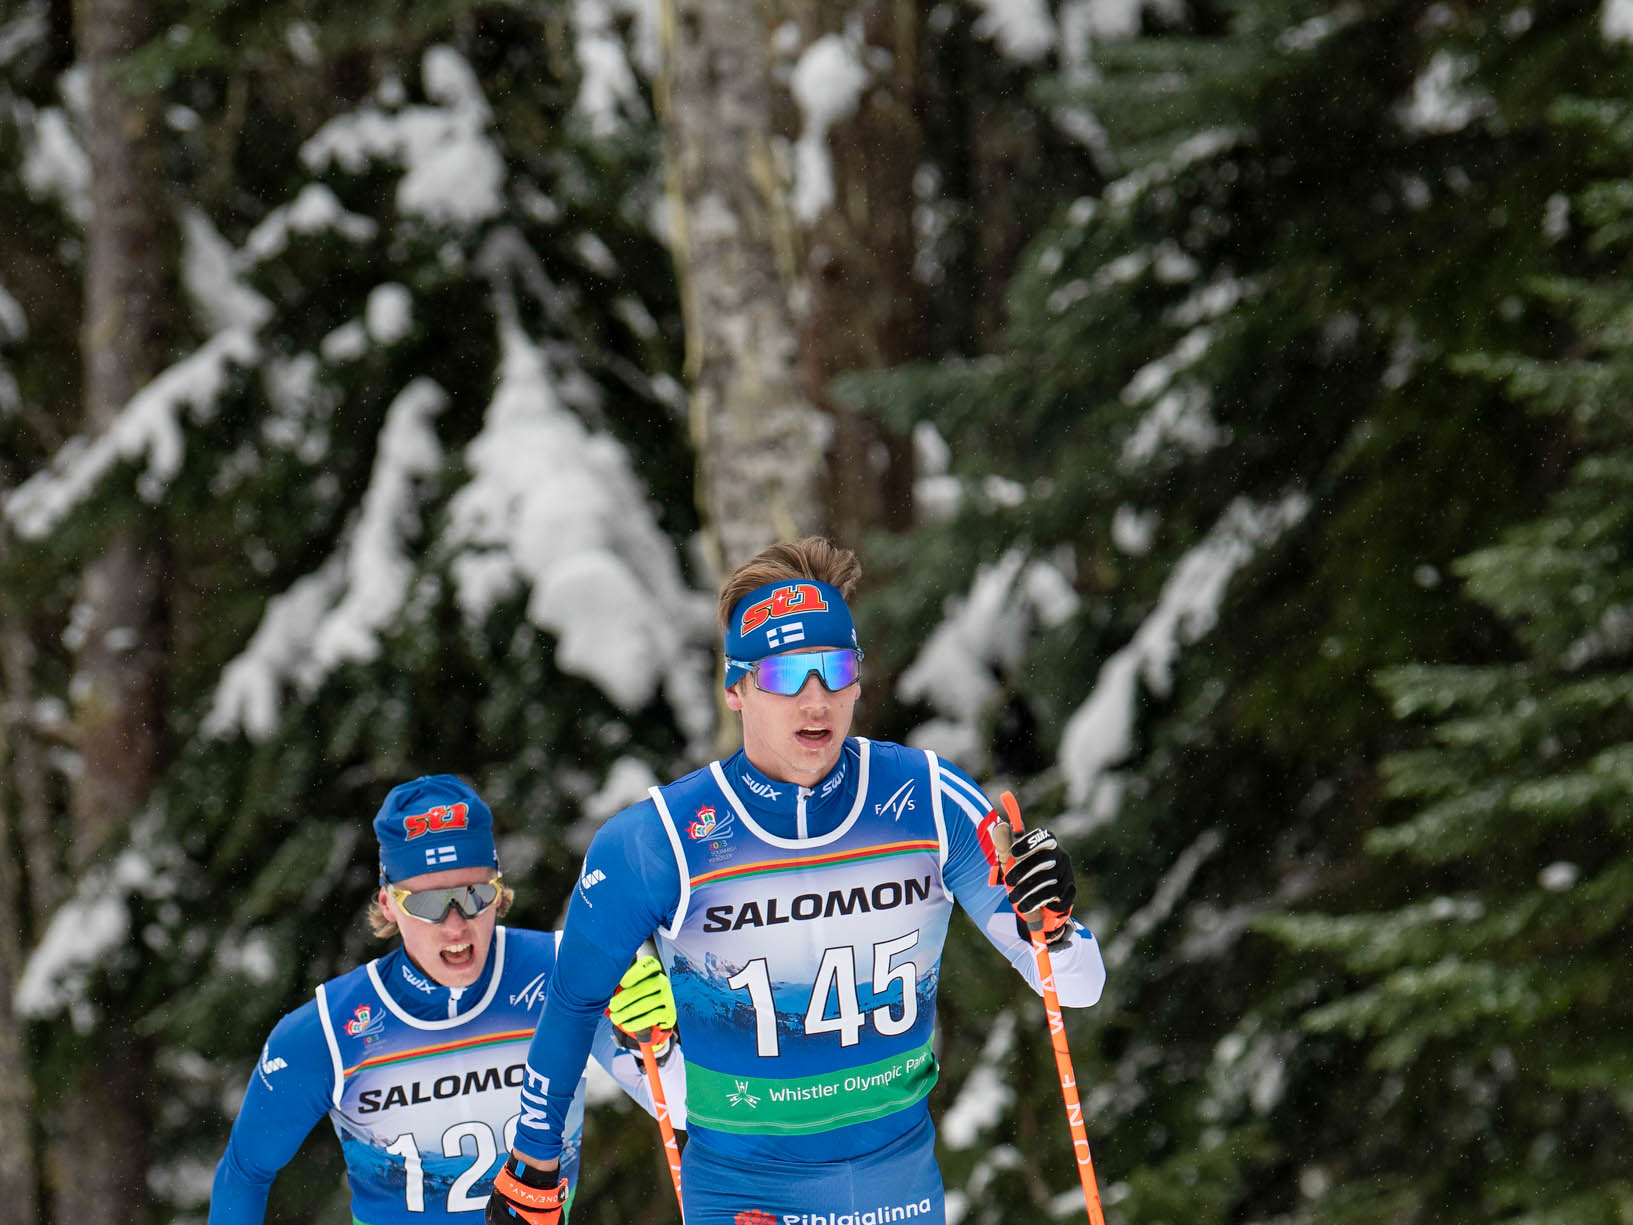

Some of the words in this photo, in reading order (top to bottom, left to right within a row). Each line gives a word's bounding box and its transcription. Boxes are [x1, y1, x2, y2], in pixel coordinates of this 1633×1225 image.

[703, 875, 932, 933] SALOMON
[727, 929, 919, 1058] 145
[357, 1063, 527, 1114] SALOMO
[520, 1062, 550, 1130] FIN
[769, 1082, 840, 1103] Whistler
[844, 1064, 902, 1092] Olympic
[385, 1112, 521, 1213] 12
